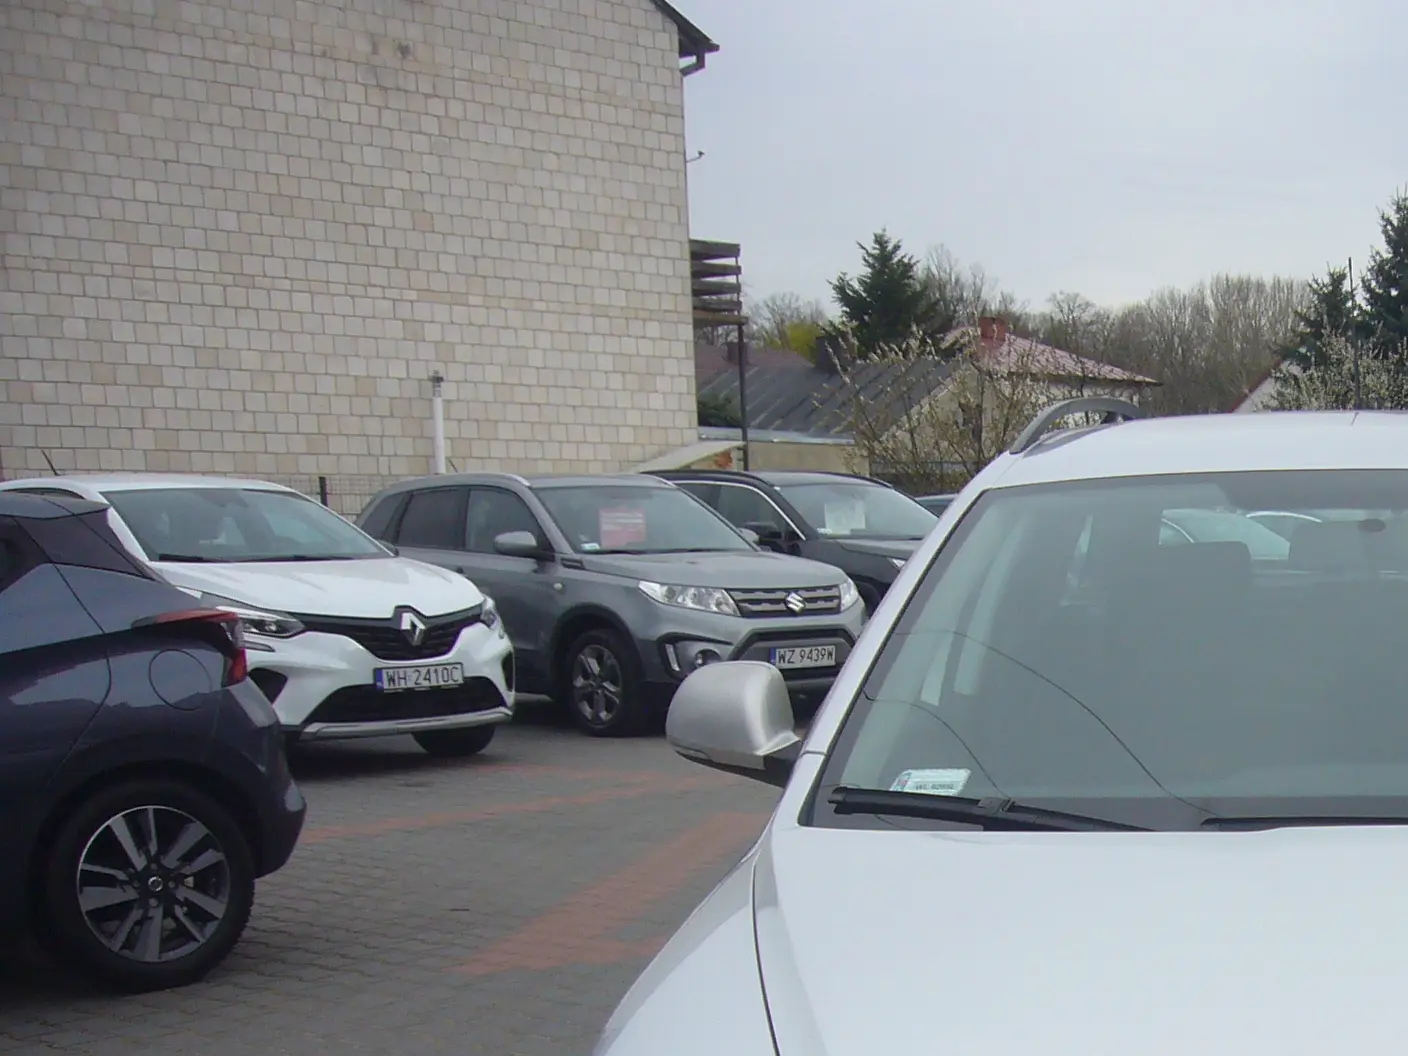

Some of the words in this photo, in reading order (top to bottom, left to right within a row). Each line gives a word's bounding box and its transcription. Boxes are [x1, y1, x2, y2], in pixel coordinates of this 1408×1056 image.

[778, 649, 796, 665] WZ
[799, 648, 834, 663] 9439W
[386, 670, 407, 687] WH
[413, 667, 459, 685] 2410C
